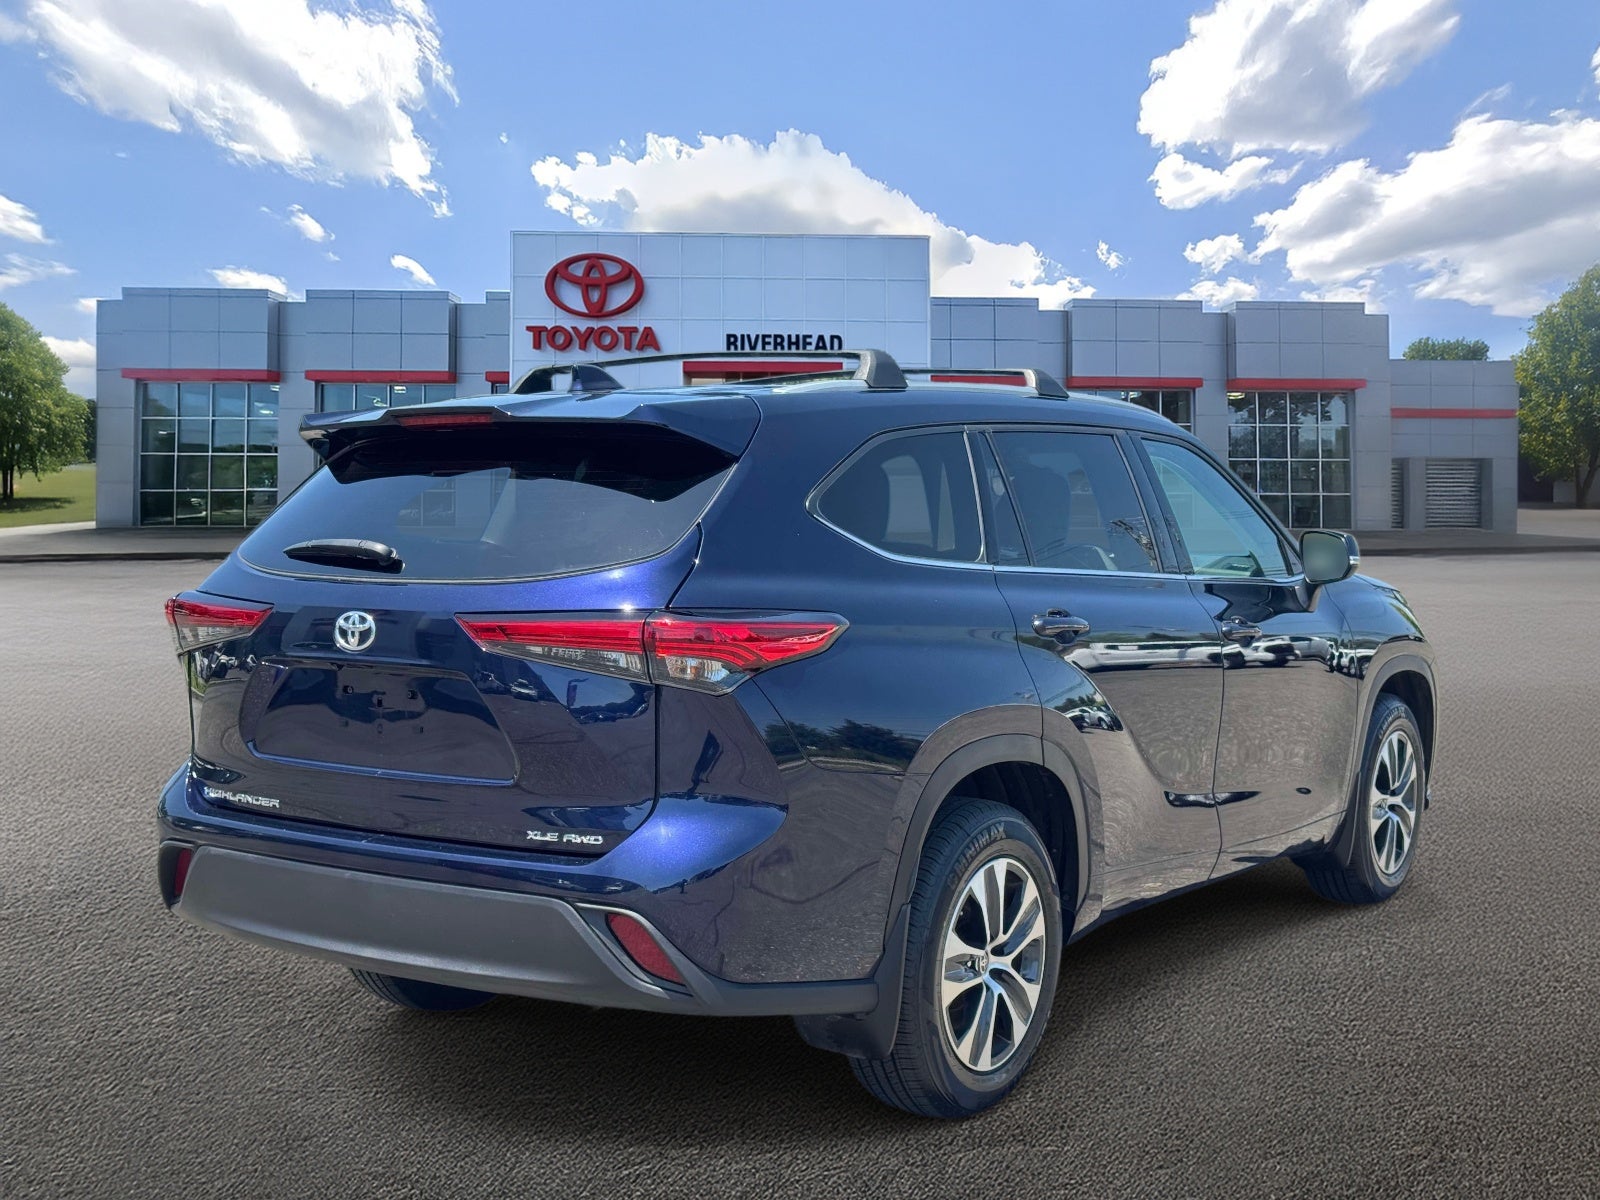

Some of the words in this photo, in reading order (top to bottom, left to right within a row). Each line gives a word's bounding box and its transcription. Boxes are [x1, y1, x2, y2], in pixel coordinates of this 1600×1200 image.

[525, 325, 661, 351] TOYOTA
[726, 333, 843, 351] RIVERHEAD
[203, 786, 280, 808] HIGHLANDER
[526, 830, 559, 842] XLE
[562, 833, 604, 845] AWD
